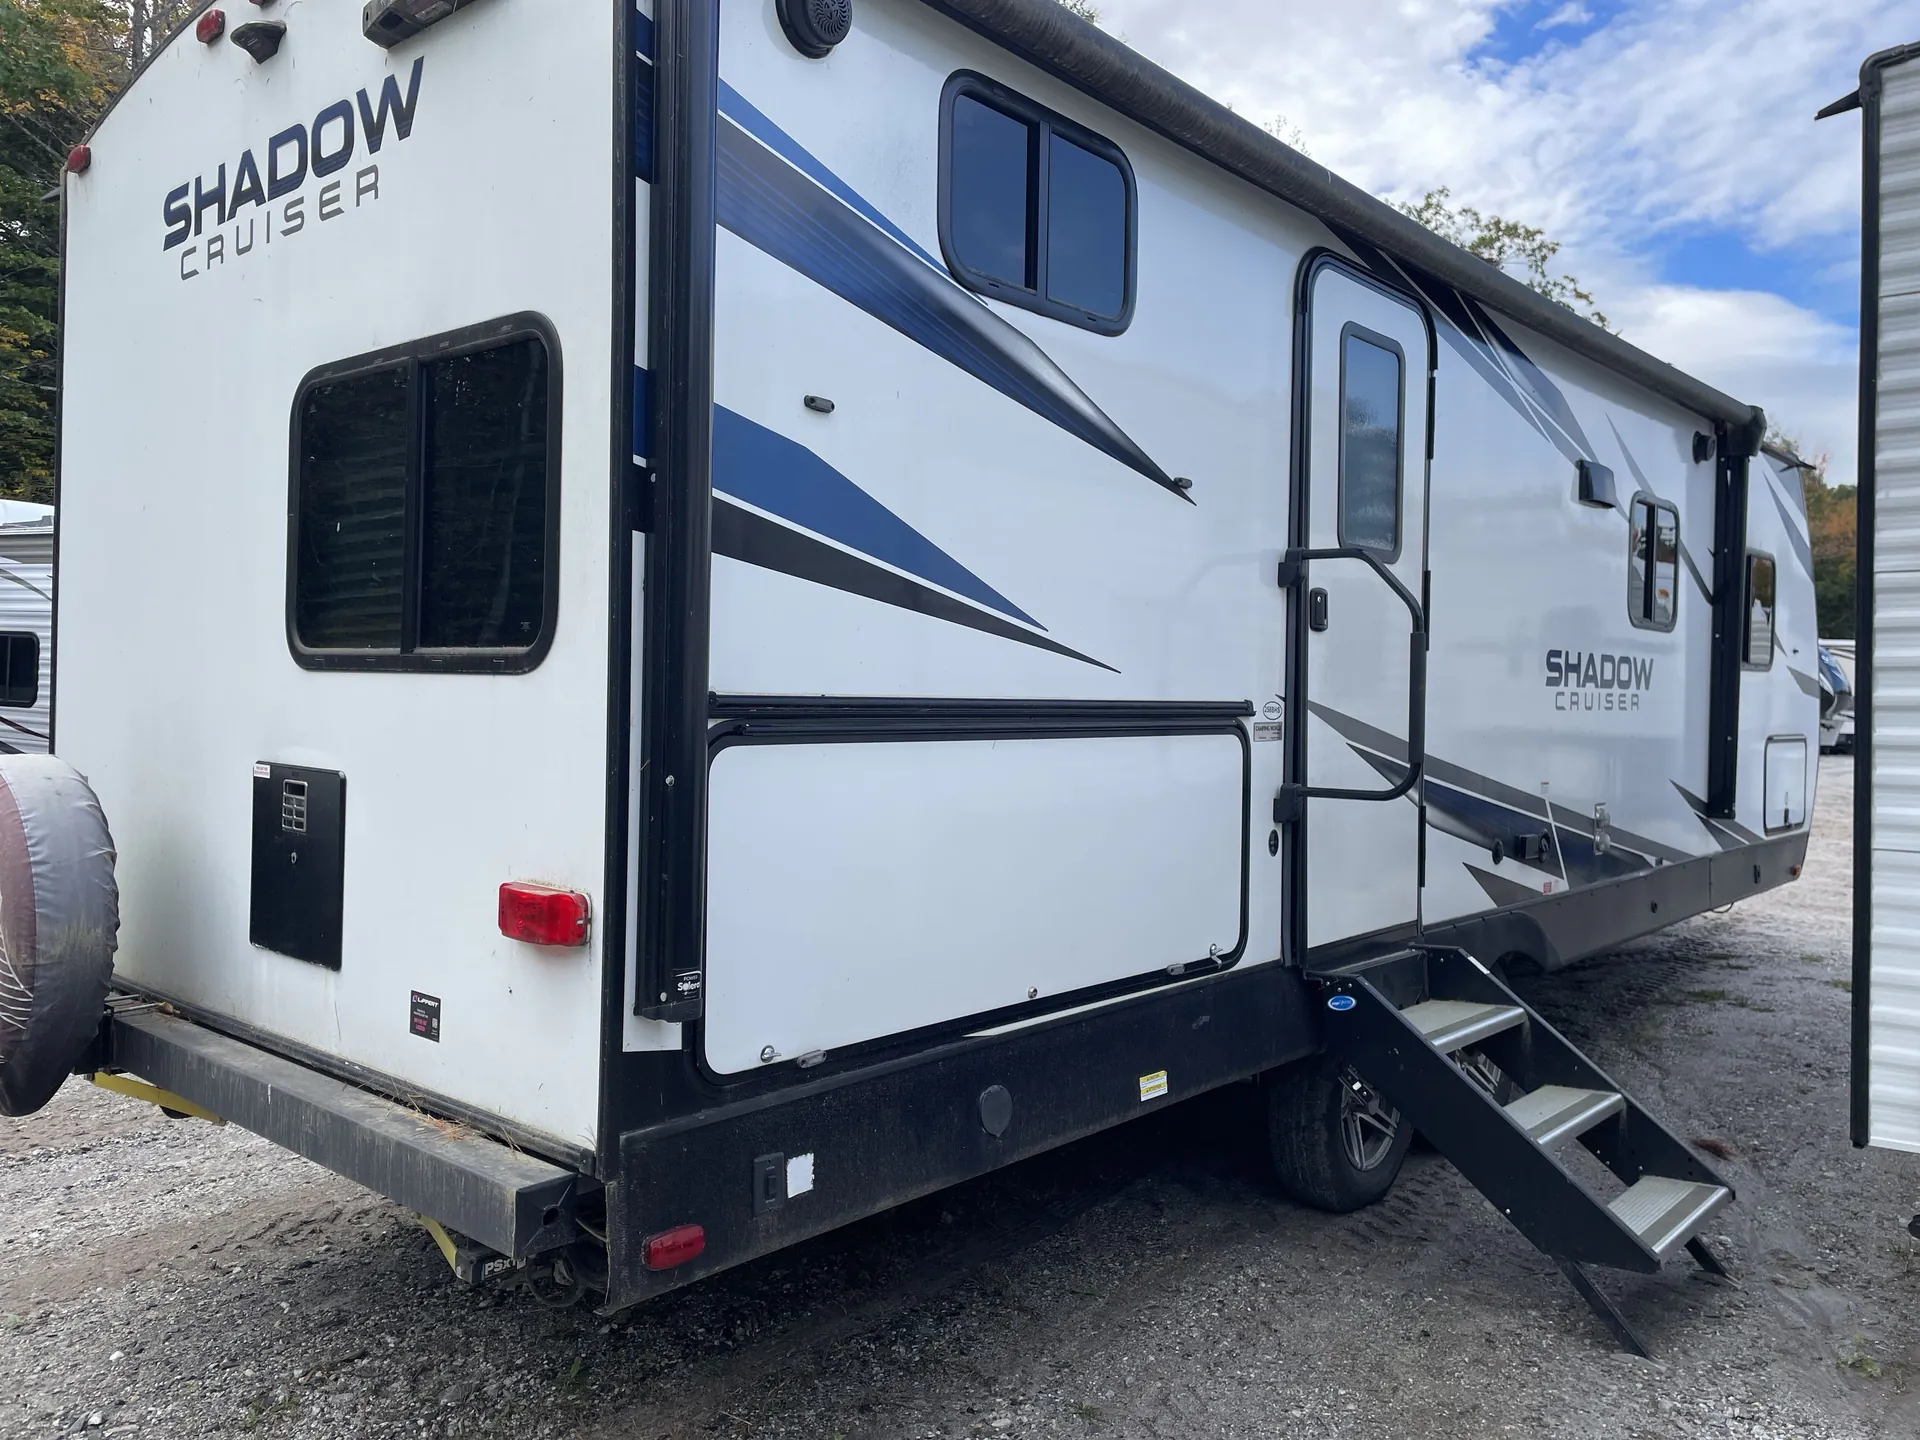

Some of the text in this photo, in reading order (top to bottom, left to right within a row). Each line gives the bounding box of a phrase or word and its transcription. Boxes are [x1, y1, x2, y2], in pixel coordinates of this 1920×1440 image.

[163, 55, 425, 252] SHADOW
[180, 164, 380, 281] CRUISER
[1545, 649, 1654, 691] SHADOW
[1555, 691, 1640, 711] CRUISER
